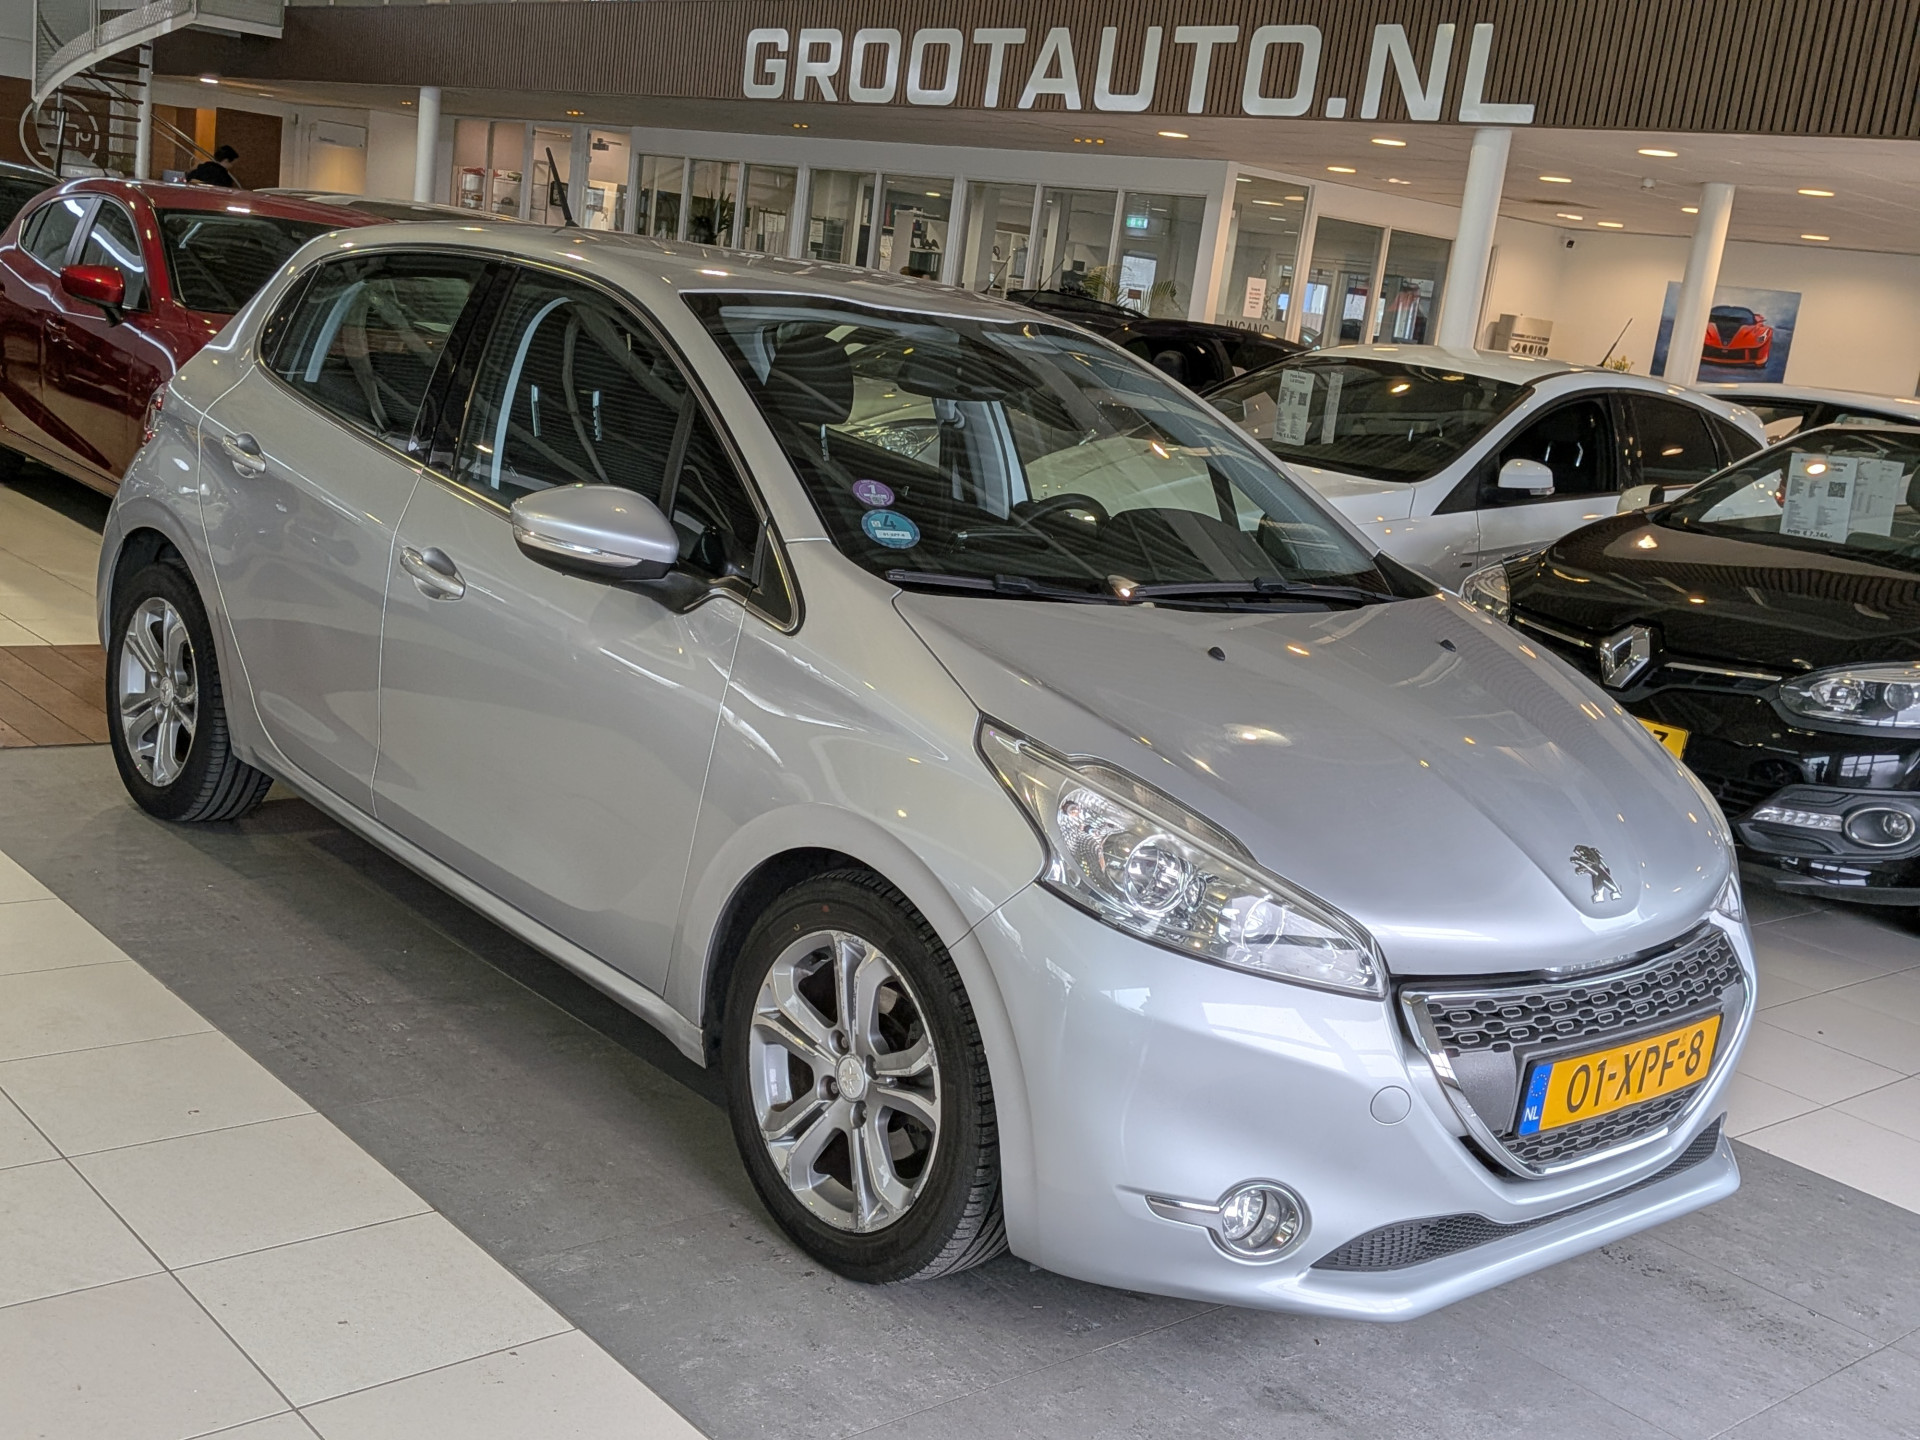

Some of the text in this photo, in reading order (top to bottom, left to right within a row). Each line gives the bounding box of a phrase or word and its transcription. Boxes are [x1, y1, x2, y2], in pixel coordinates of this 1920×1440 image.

[742, 22, 1536, 125] GROOTAUTO.NL
[883, 514, 897, 530] 4
[1566, 1029, 1705, 1113] 01-XPF-8
[1524, 1105, 1539, 1122] NL
